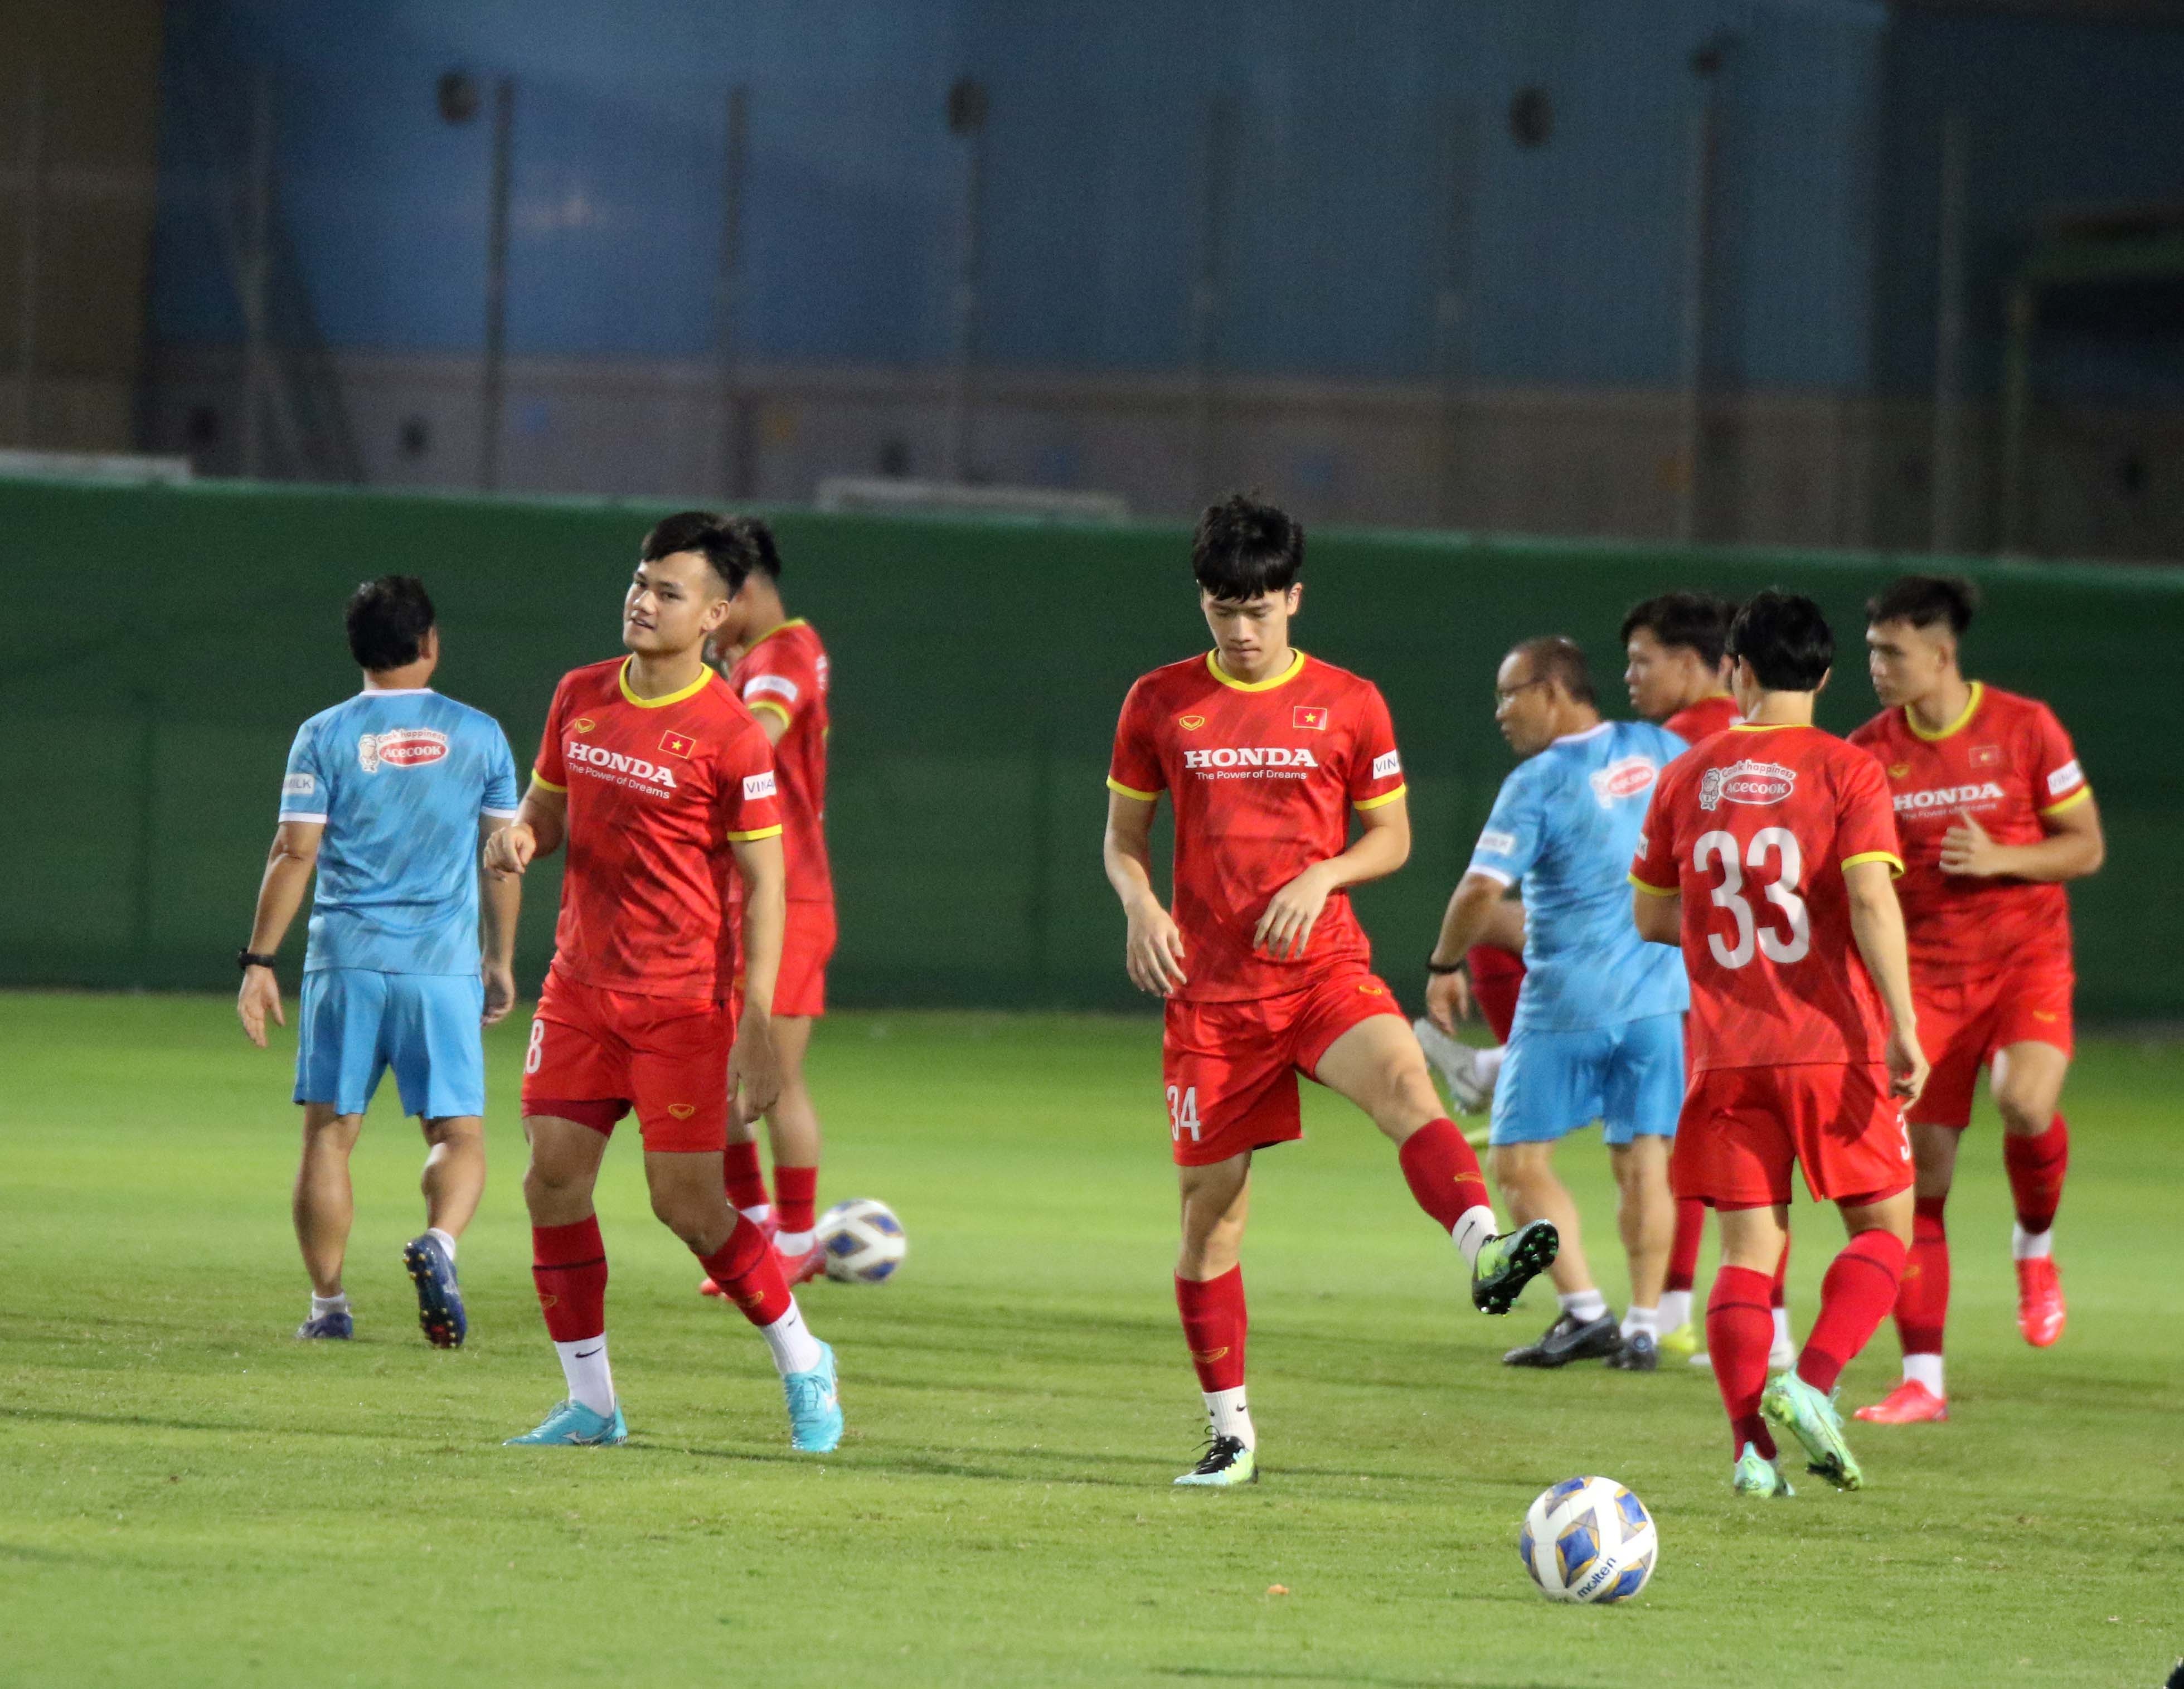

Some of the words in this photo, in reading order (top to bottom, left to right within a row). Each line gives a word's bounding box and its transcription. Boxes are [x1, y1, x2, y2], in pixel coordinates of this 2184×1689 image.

[378, 732, 397, 743] Cook
[401, 729, 445, 741] happiness
[567, 742, 677, 788] HONDA
[1183, 748, 1318, 769] HONDA
[1196, 771, 1214, 780] The
[1217, 770, 1251, 779] Power
[1253, 770, 1264, 778] of
[1266, 769, 1307, 779] Dreams
[1376, 757, 1397, 772] VIN
[1722, 763, 1744, 777] Cook
[1746, 761, 1794, 778] happiness
[569, 762, 585, 774] The
[585, 767, 616, 781] Power
[617, 775, 628, 785] of
[628, 779, 669, 799] Dreams
[1893, 783, 2005, 811] HONDA
[1693, 827, 1809, 969] 33
[523, 1018, 545, 1074] 8
[1167, 1085, 1201, 1142] 34
[1577, 1557, 1616, 1598] molten
